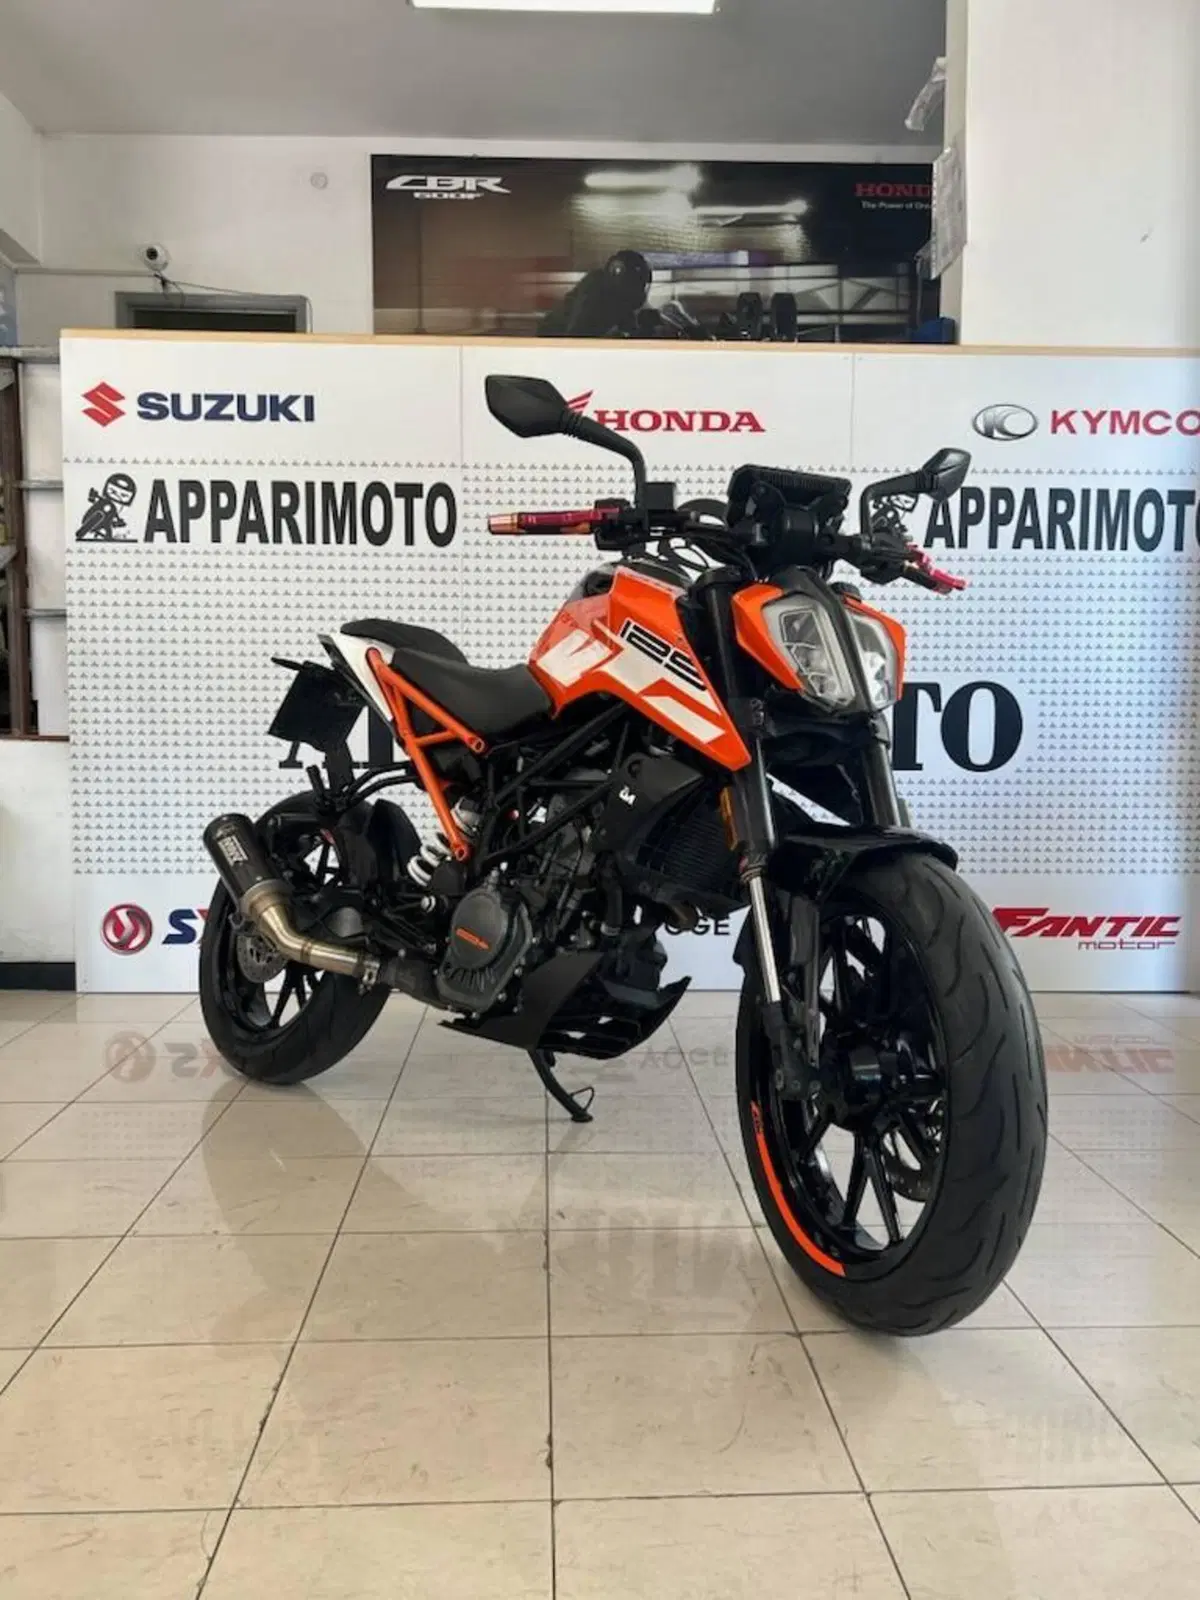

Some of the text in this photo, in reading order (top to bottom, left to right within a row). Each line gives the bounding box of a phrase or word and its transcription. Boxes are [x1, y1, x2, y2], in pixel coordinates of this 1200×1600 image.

[386, 175, 511, 193] CBR
[855, 183, 932, 197] HOND
[137, 392, 315, 422] SUZUKI
[594, 410, 765, 432] HONDA
[1051, 410, 1200, 436] KYMCO
[143, 479, 457, 547] APPARIMOTO
[924, 487, 1200, 552] APPARIMOT
[992, 907, 1181, 937] FANTIC
[1078, 938, 1176, 950] motor
